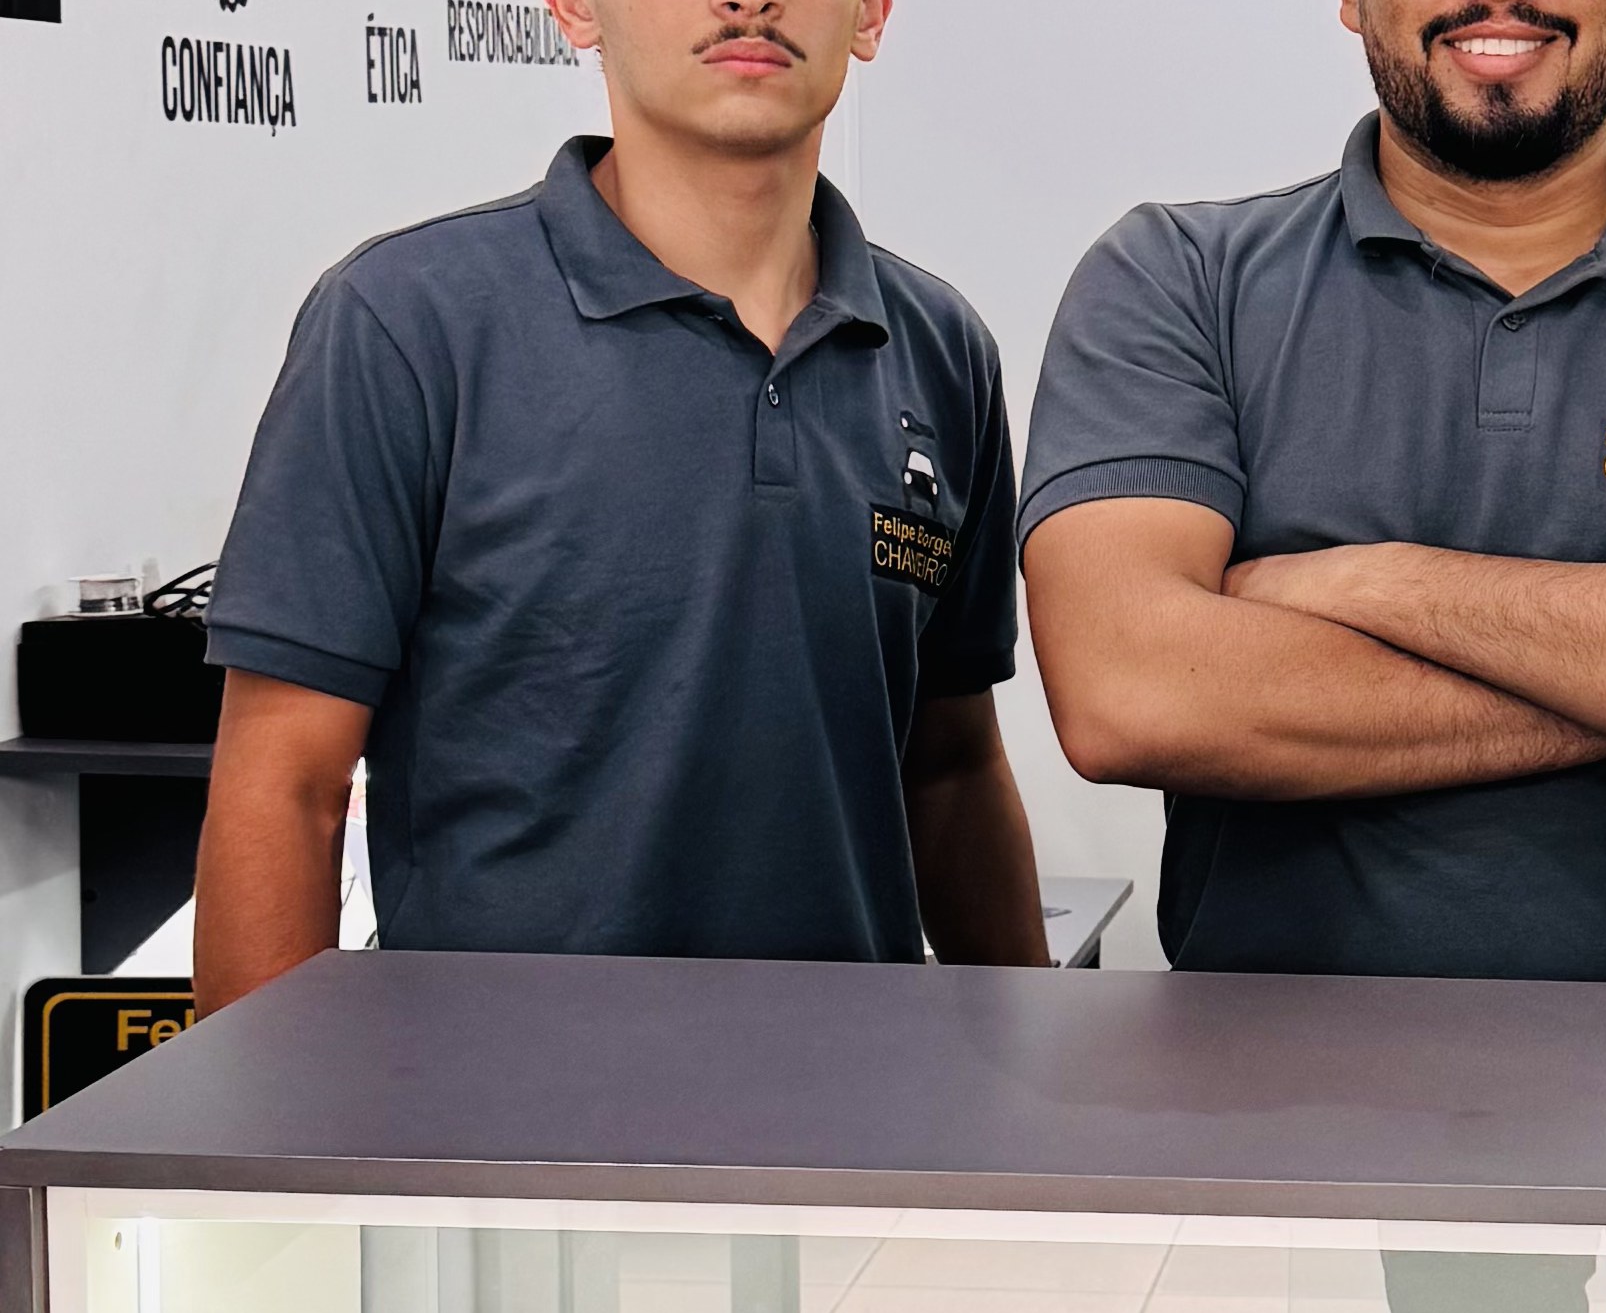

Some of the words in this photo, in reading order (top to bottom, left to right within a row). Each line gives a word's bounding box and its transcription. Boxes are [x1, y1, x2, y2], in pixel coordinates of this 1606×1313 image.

[161, 35, 297, 137] CONFIANÇA
[365, 13, 422, 104] ÉTICA
[873, 511, 916, 542] Felipe
